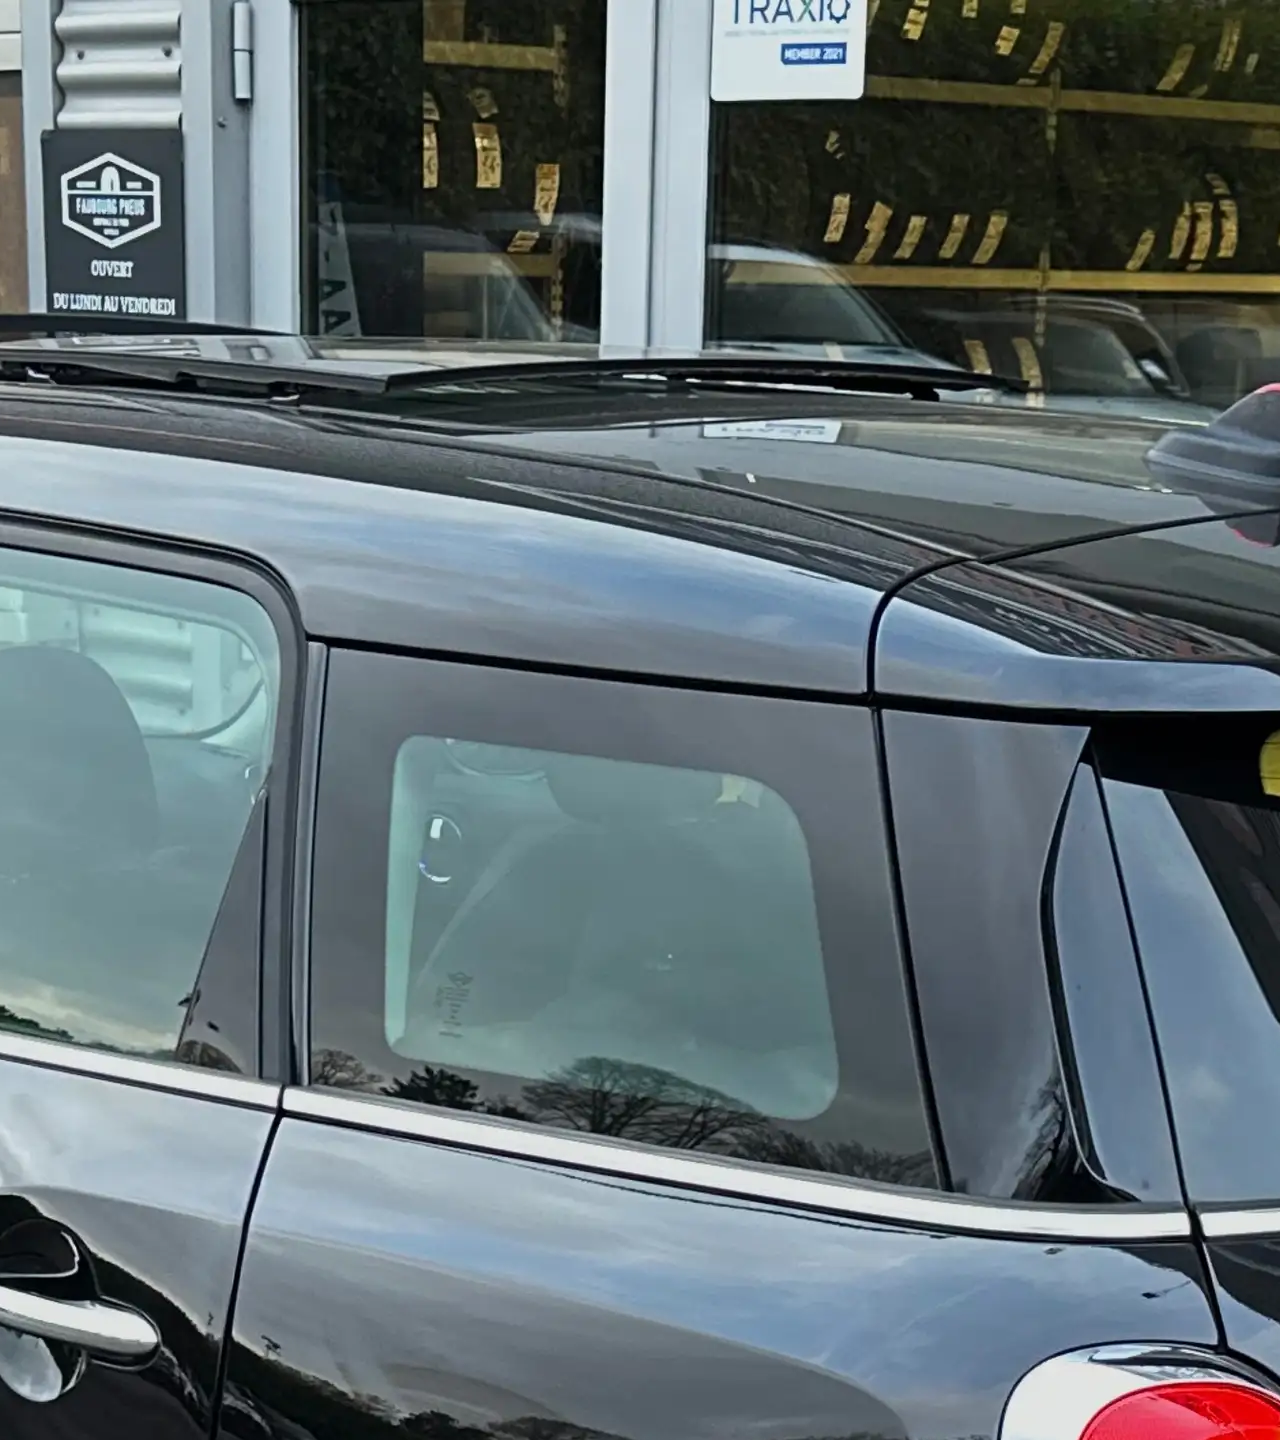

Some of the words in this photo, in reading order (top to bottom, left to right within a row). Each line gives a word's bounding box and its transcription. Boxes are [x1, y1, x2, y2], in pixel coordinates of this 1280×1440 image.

[784, 47, 821, 61] MEMBER
[823, 47, 844, 60] 2021
[119, 199, 146, 216] PNEUS
[90, 259, 134, 278] OUVERT
[53, 292, 69, 310] DU
[69, 293, 102, 312] LUNDI
[103, 295, 119, 313] AU
[120, 296, 177, 316] VENDREDI
